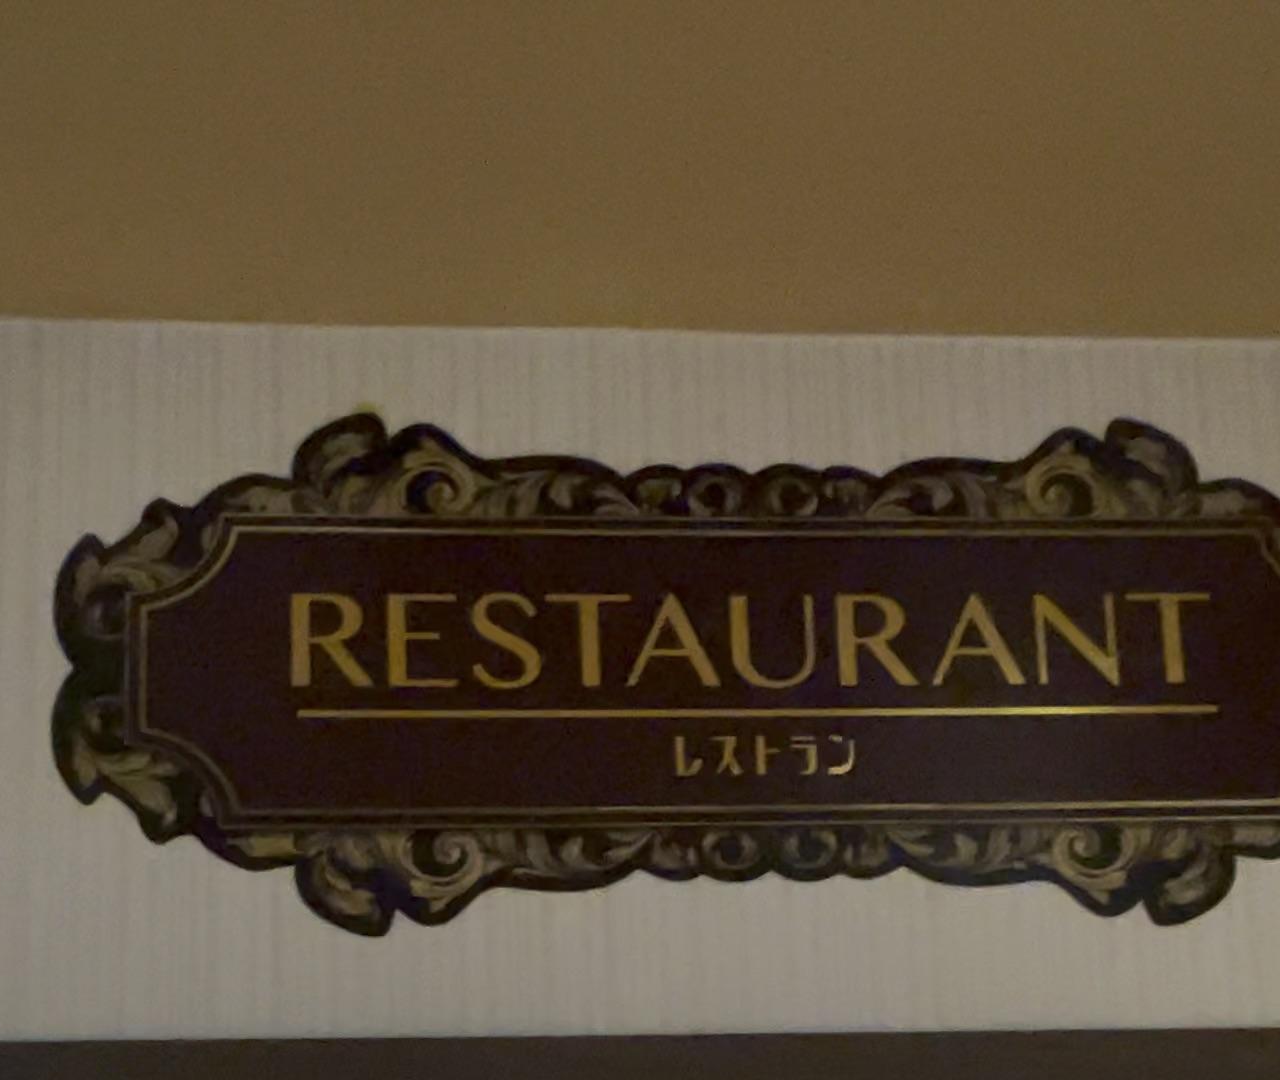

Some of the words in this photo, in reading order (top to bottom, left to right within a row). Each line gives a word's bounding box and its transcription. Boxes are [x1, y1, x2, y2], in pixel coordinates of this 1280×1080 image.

[290, 592, 1211, 689] RESTAURANT
[674, 734, 856, 776] レストラン
